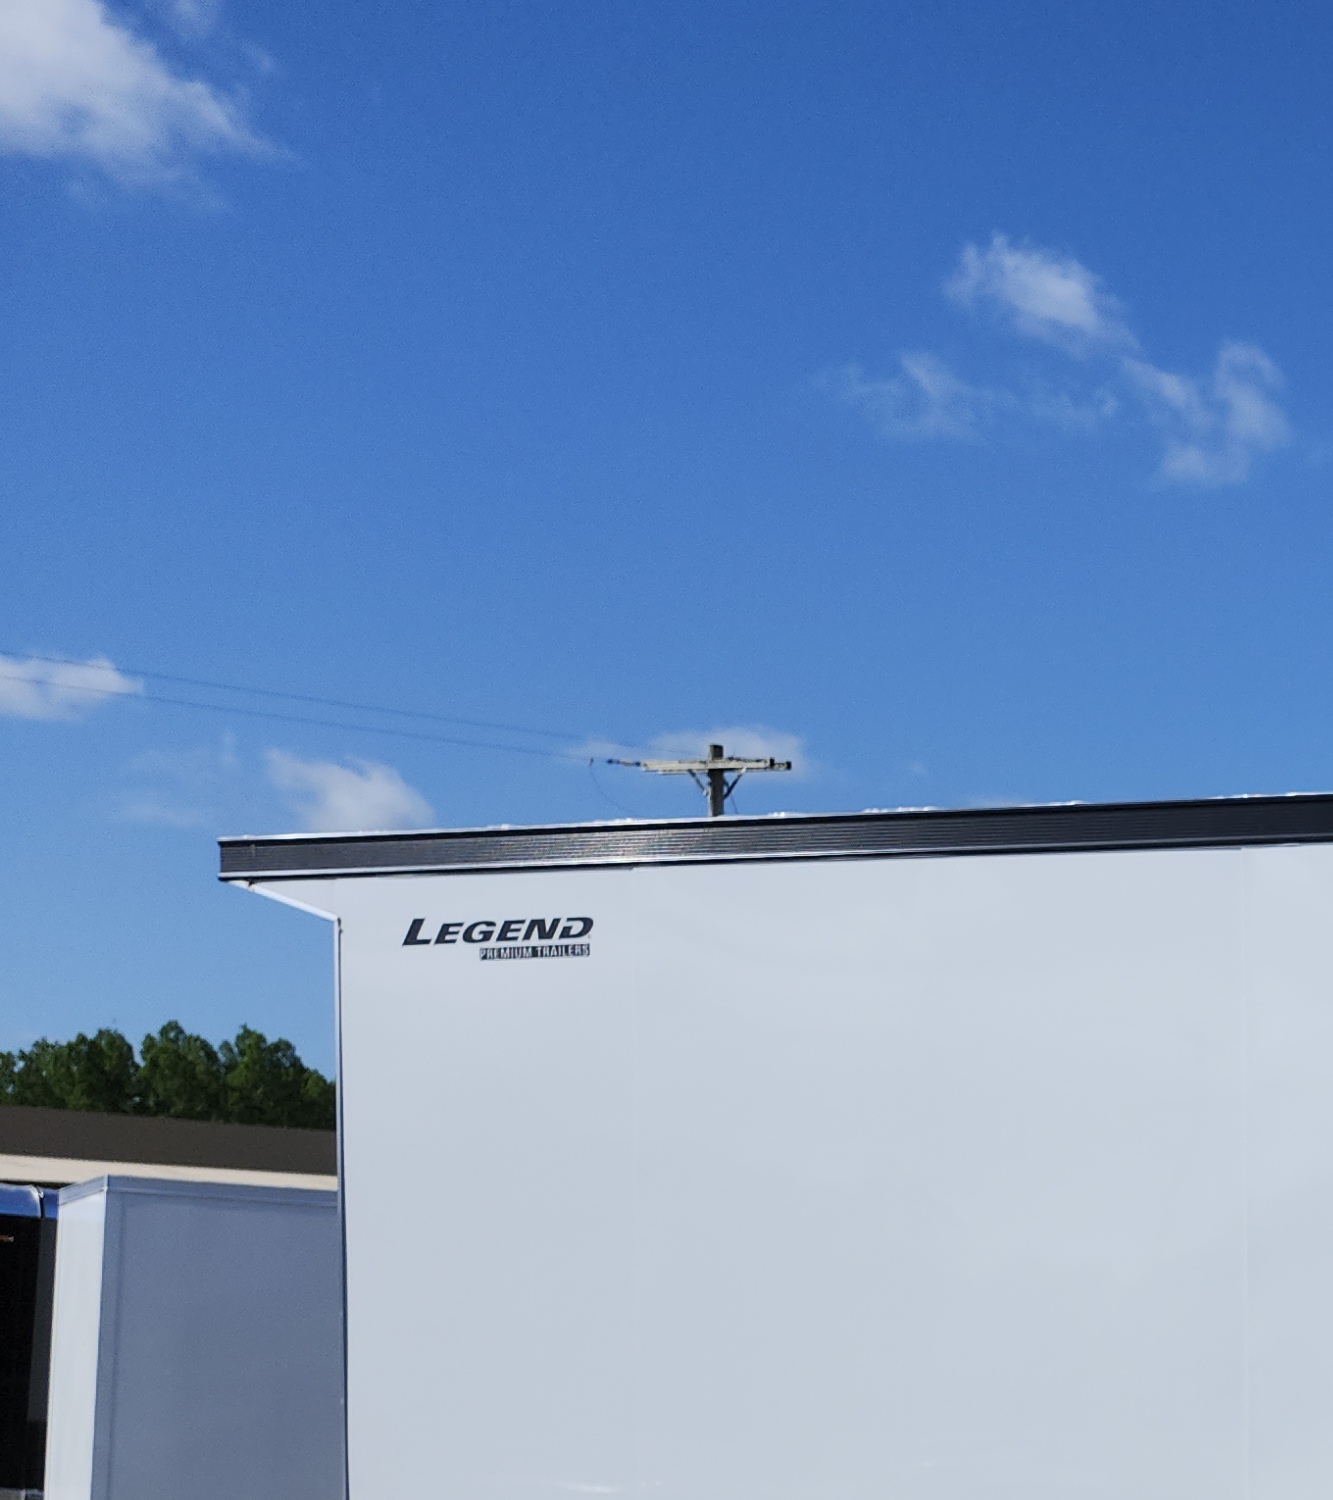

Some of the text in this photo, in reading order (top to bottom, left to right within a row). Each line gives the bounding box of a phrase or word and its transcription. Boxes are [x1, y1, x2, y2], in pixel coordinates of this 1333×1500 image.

[402, 917, 594, 947] LEGEND
[480, 944, 590, 960] PREMIUM TRAILERS
